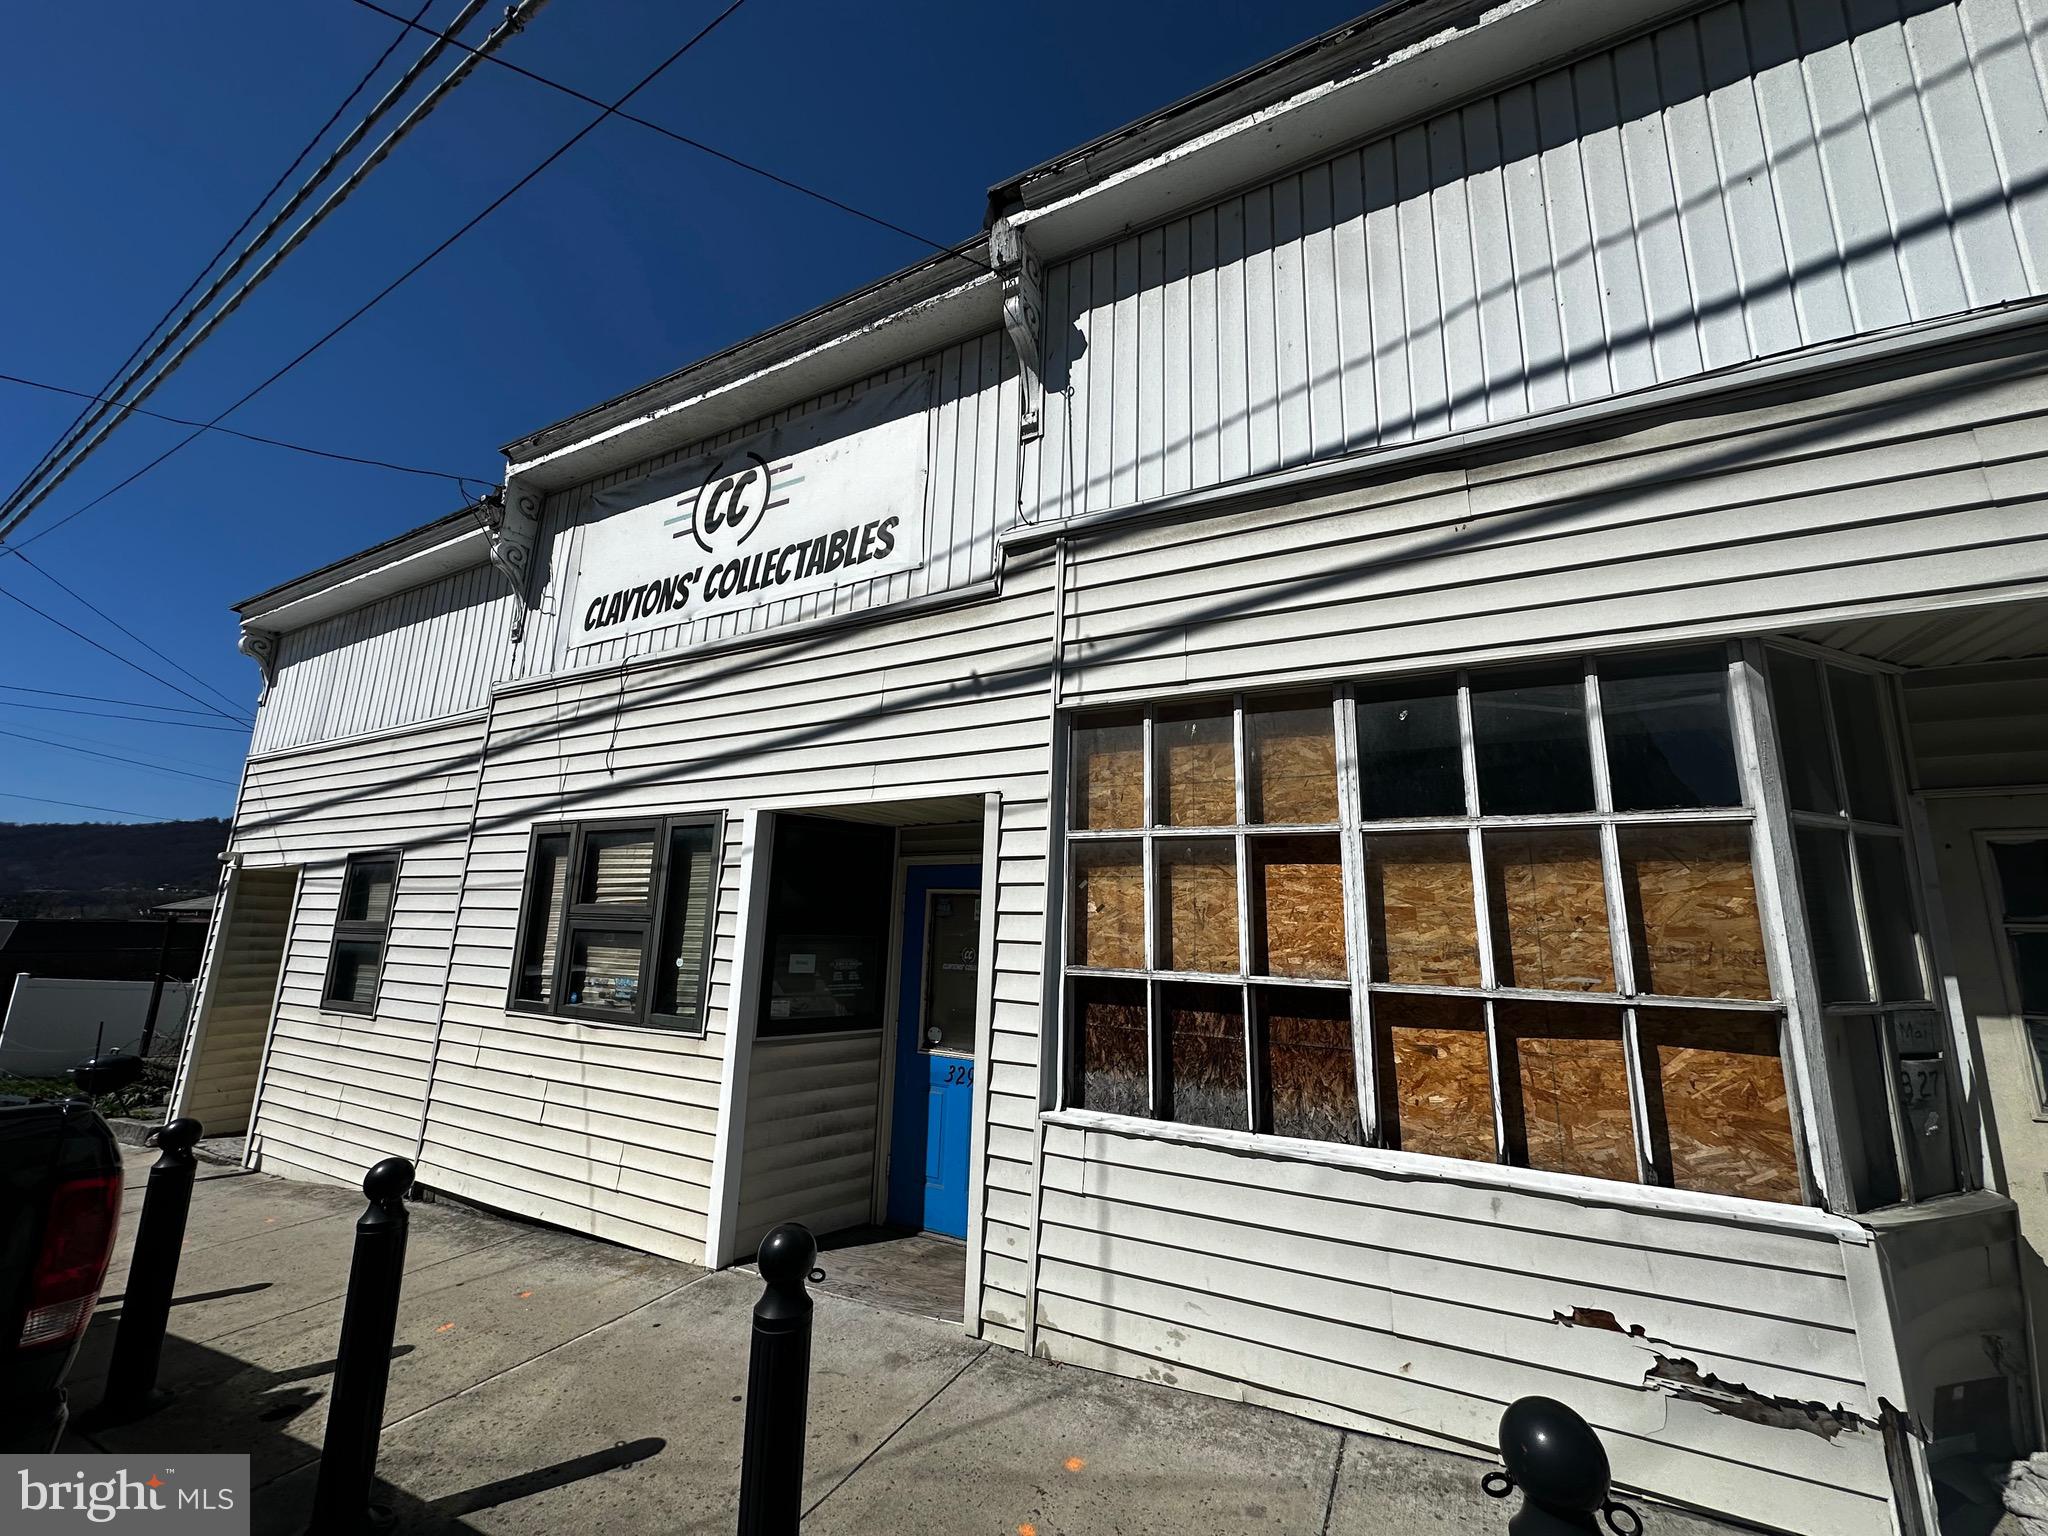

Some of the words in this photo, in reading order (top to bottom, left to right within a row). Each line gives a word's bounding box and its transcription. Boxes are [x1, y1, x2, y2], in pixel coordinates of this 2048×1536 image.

[704, 469, 758, 535] CC
[584, 566, 702, 632] CLAYTONS'
[703, 516, 900, 603] COLLECTABLES
[944, 1065, 974, 1088] 329
